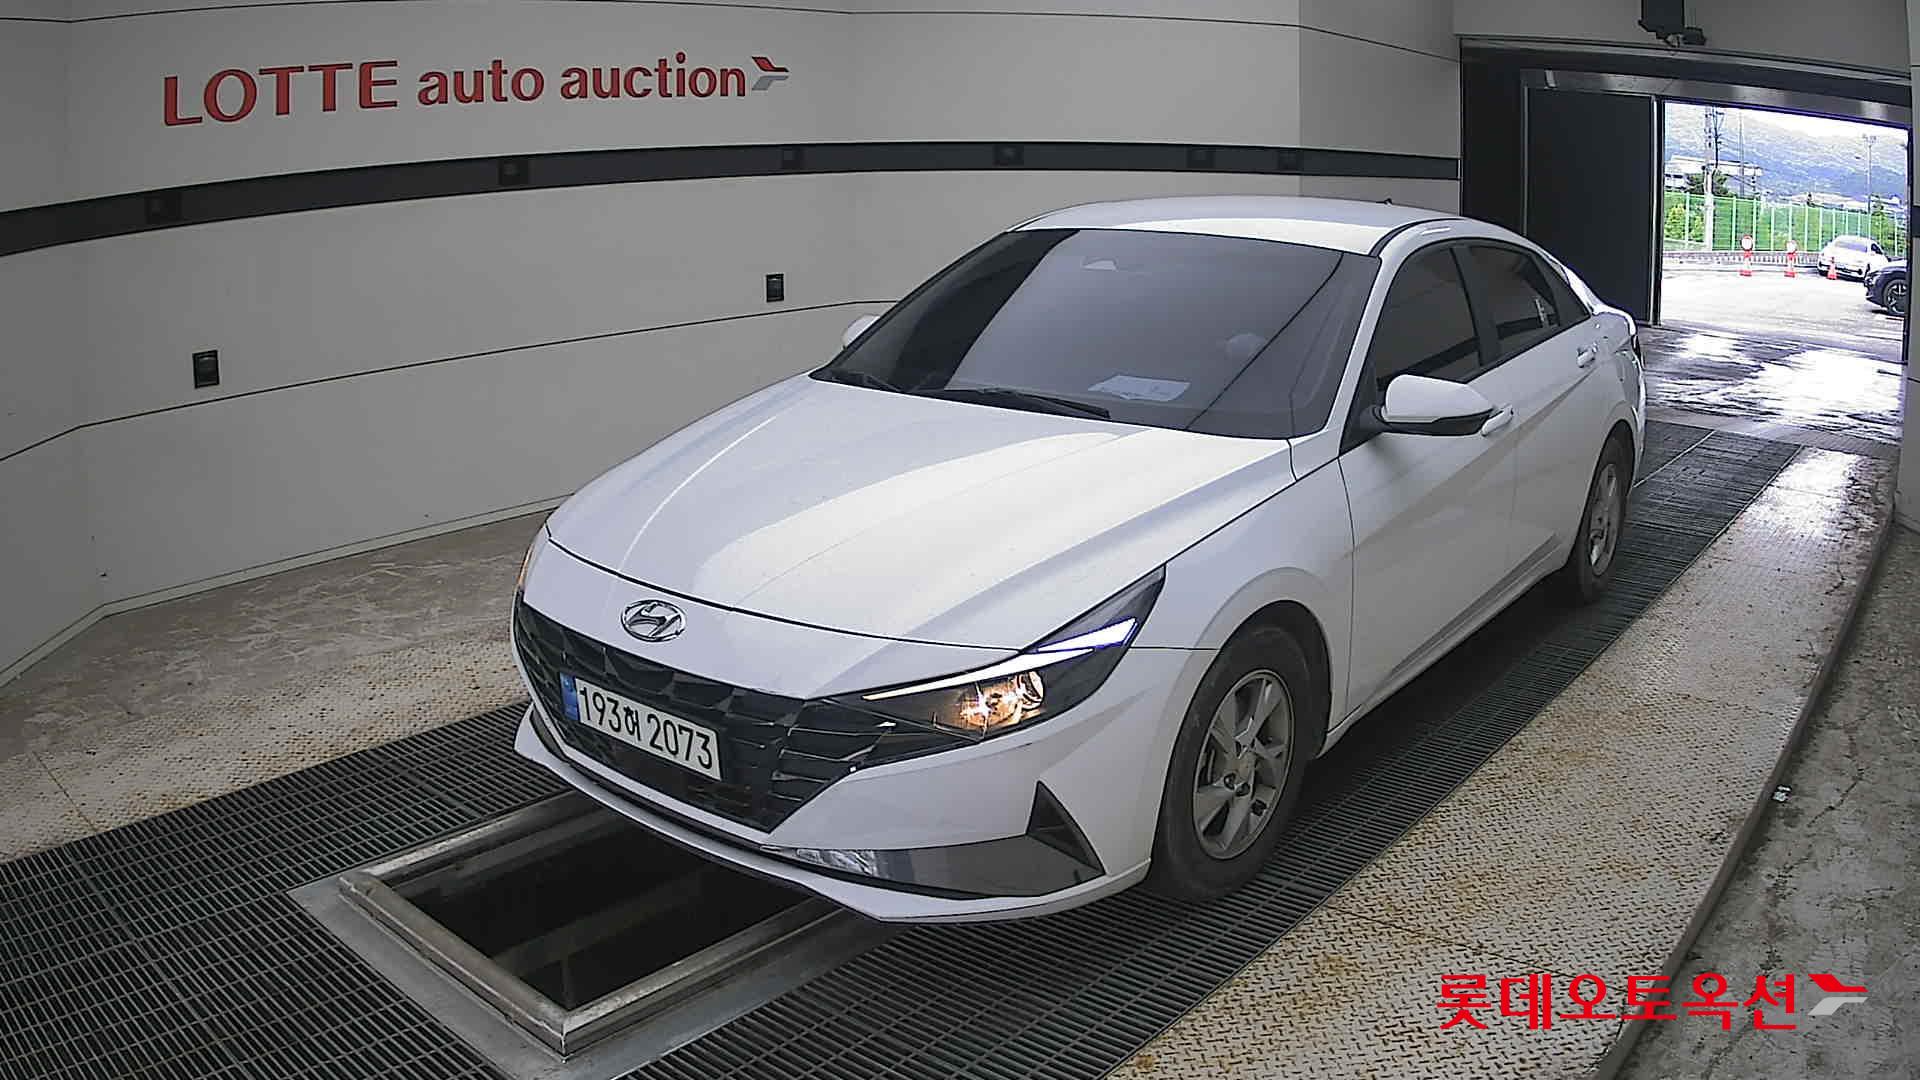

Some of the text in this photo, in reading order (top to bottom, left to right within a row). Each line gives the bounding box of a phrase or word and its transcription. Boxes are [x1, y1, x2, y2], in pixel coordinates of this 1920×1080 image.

[163, 51, 747, 126] LOTTE auto auction
